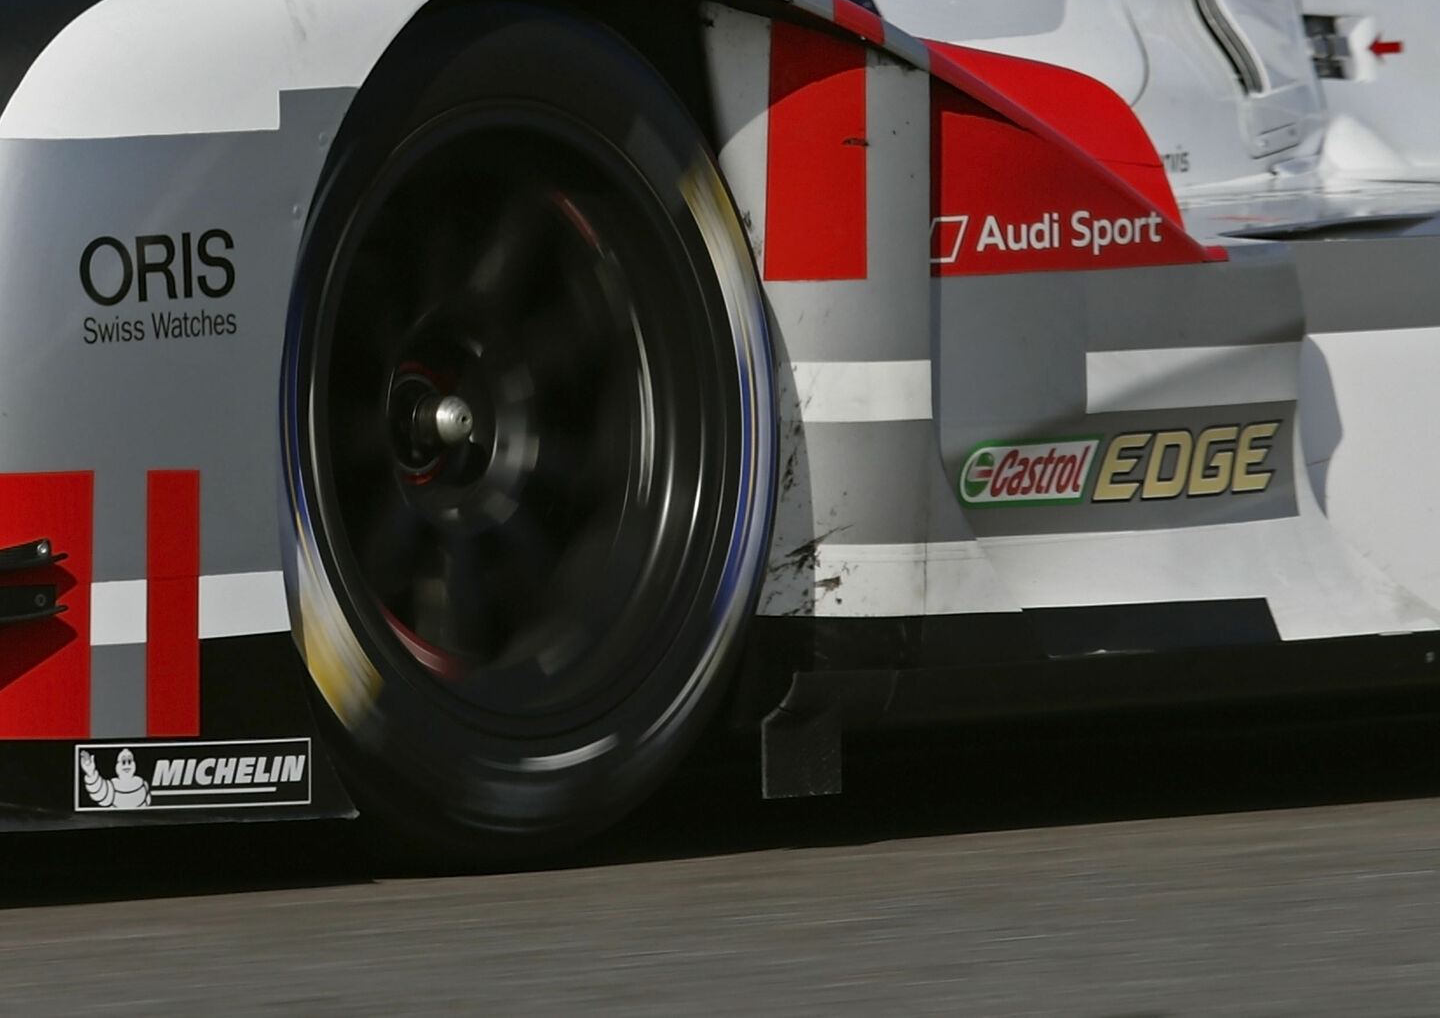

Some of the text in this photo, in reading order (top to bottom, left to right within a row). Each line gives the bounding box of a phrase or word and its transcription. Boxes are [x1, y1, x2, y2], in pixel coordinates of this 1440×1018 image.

[976, 209, 1162, 256] Audi Sport
[79, 228, 236, 307] ORIS
[83, 309, 237, 345] Swiss Watches
[990, 419, 1283, 503] Castrol EDGE
[152, 755, 306, 787] MICHELIN
